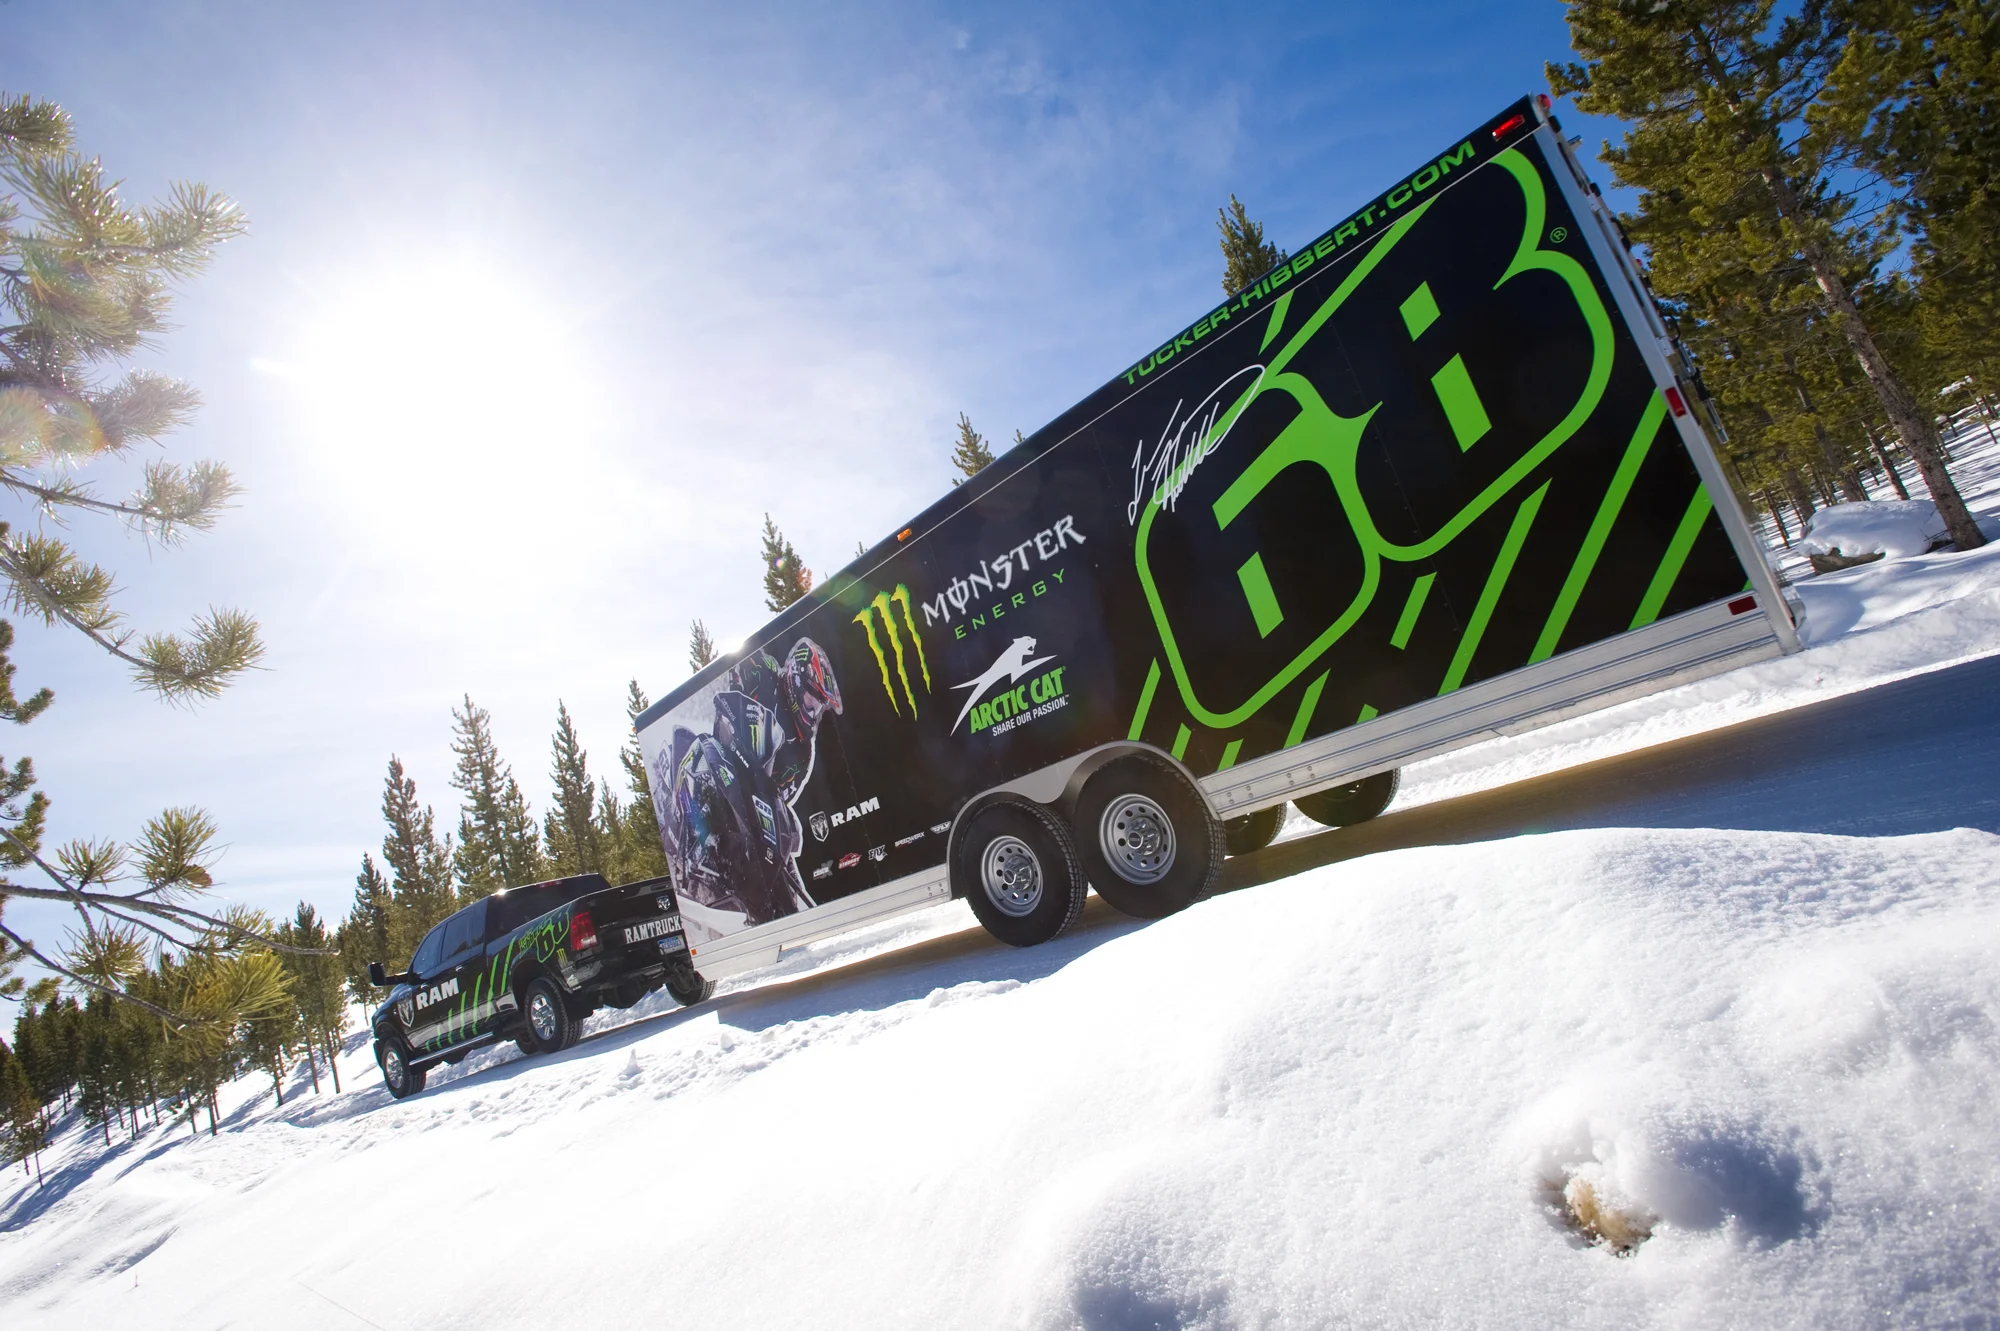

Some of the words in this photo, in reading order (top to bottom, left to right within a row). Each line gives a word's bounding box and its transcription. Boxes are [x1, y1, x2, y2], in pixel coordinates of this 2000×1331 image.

[1120, 140, 1476, 386] TUCKER-HIBBERT.COM
[921, 514, 1087, 628] MONSTER
[954, 568, 1066, 640] ENERGY
[970, 684, 1029, 734] ARCTIC
[1030, 667, 1064, 704] CAT
[992, 718, 1016, 737] SHARE
[1016, 711, 1032, 726] OUR
[830, 796, 881, 828] RAM
[624, 915, 684, 945] RAMTRUCK
[416, 977, 460, 1011] RAM
